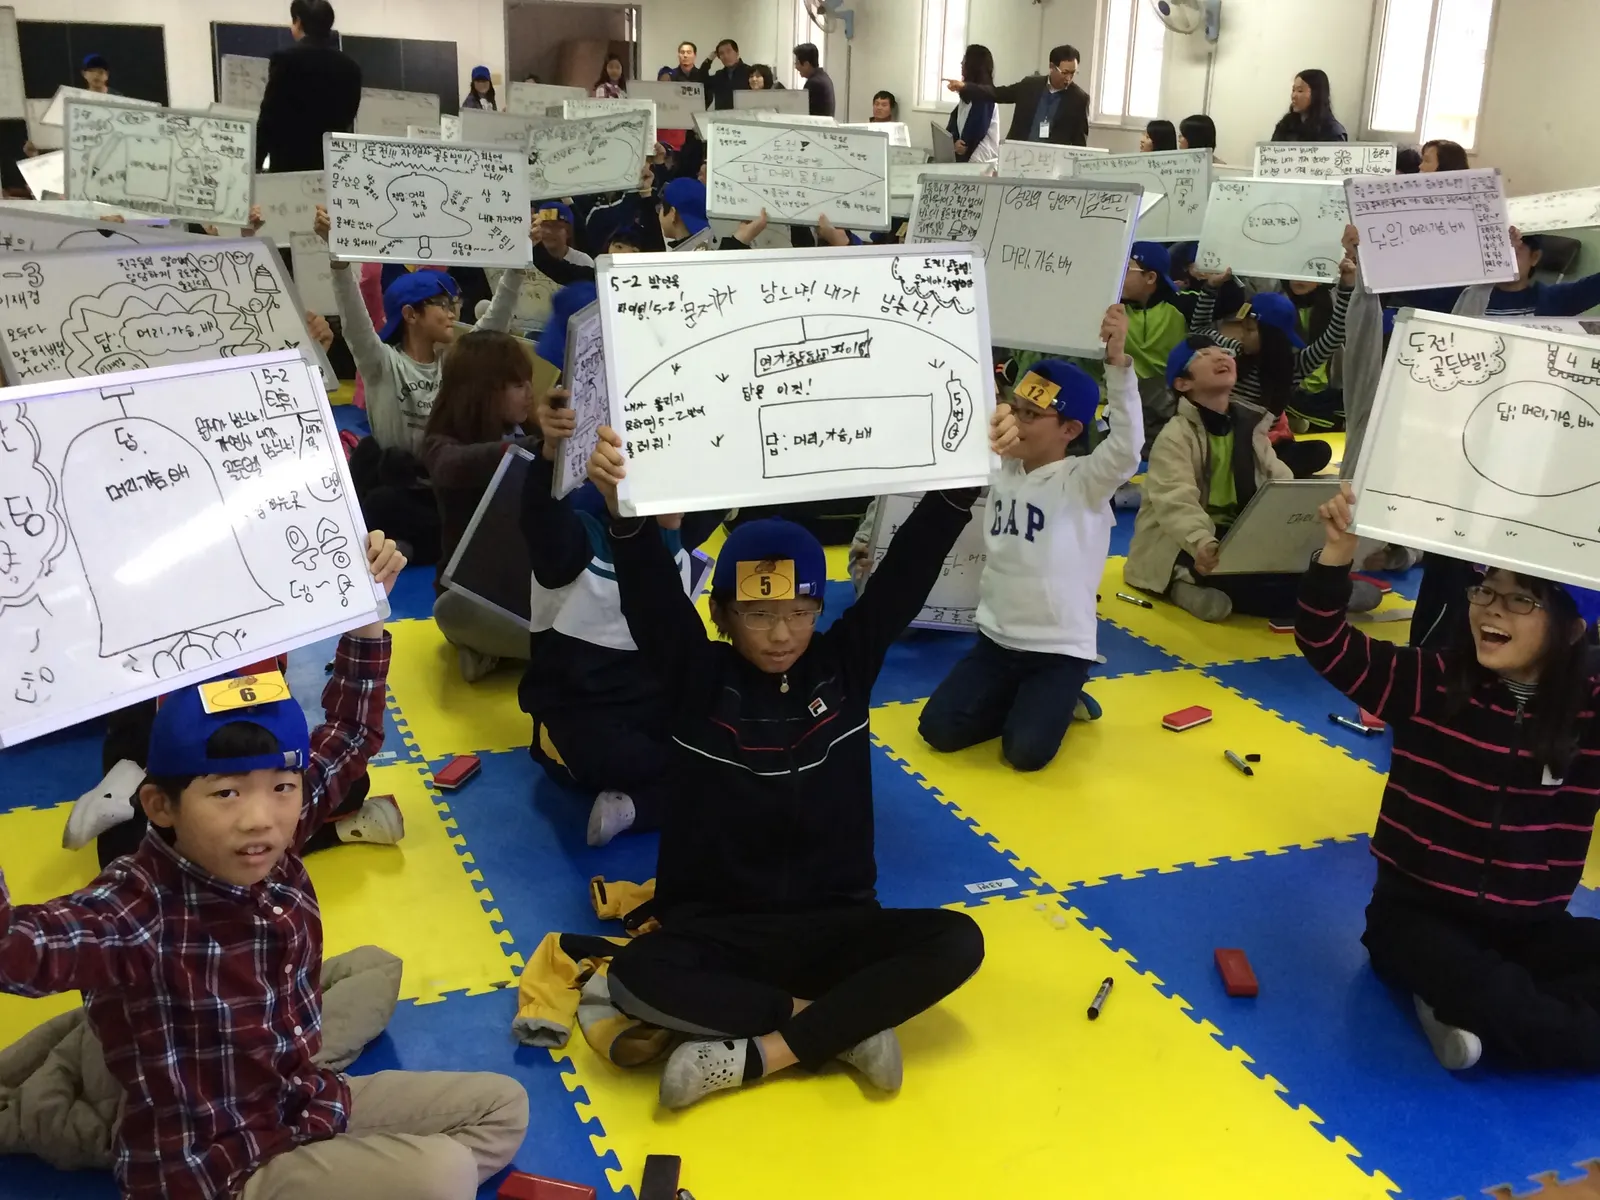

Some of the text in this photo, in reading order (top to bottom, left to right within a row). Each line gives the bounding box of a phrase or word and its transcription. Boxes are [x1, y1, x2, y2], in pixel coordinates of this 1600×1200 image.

[824, 284, 860, 303] 내가
[1408, 332, 1455, 353] 도전!
[1429, 352, 1488, 377] 골든벨!
[262, 368, 289, 384] 5-2
[1027, 385, 1045, 401] 12
[990, 499, 1045, 544] GAP
[760, 576, 771, 596] 5
[239, 687, 256, 702] 6
